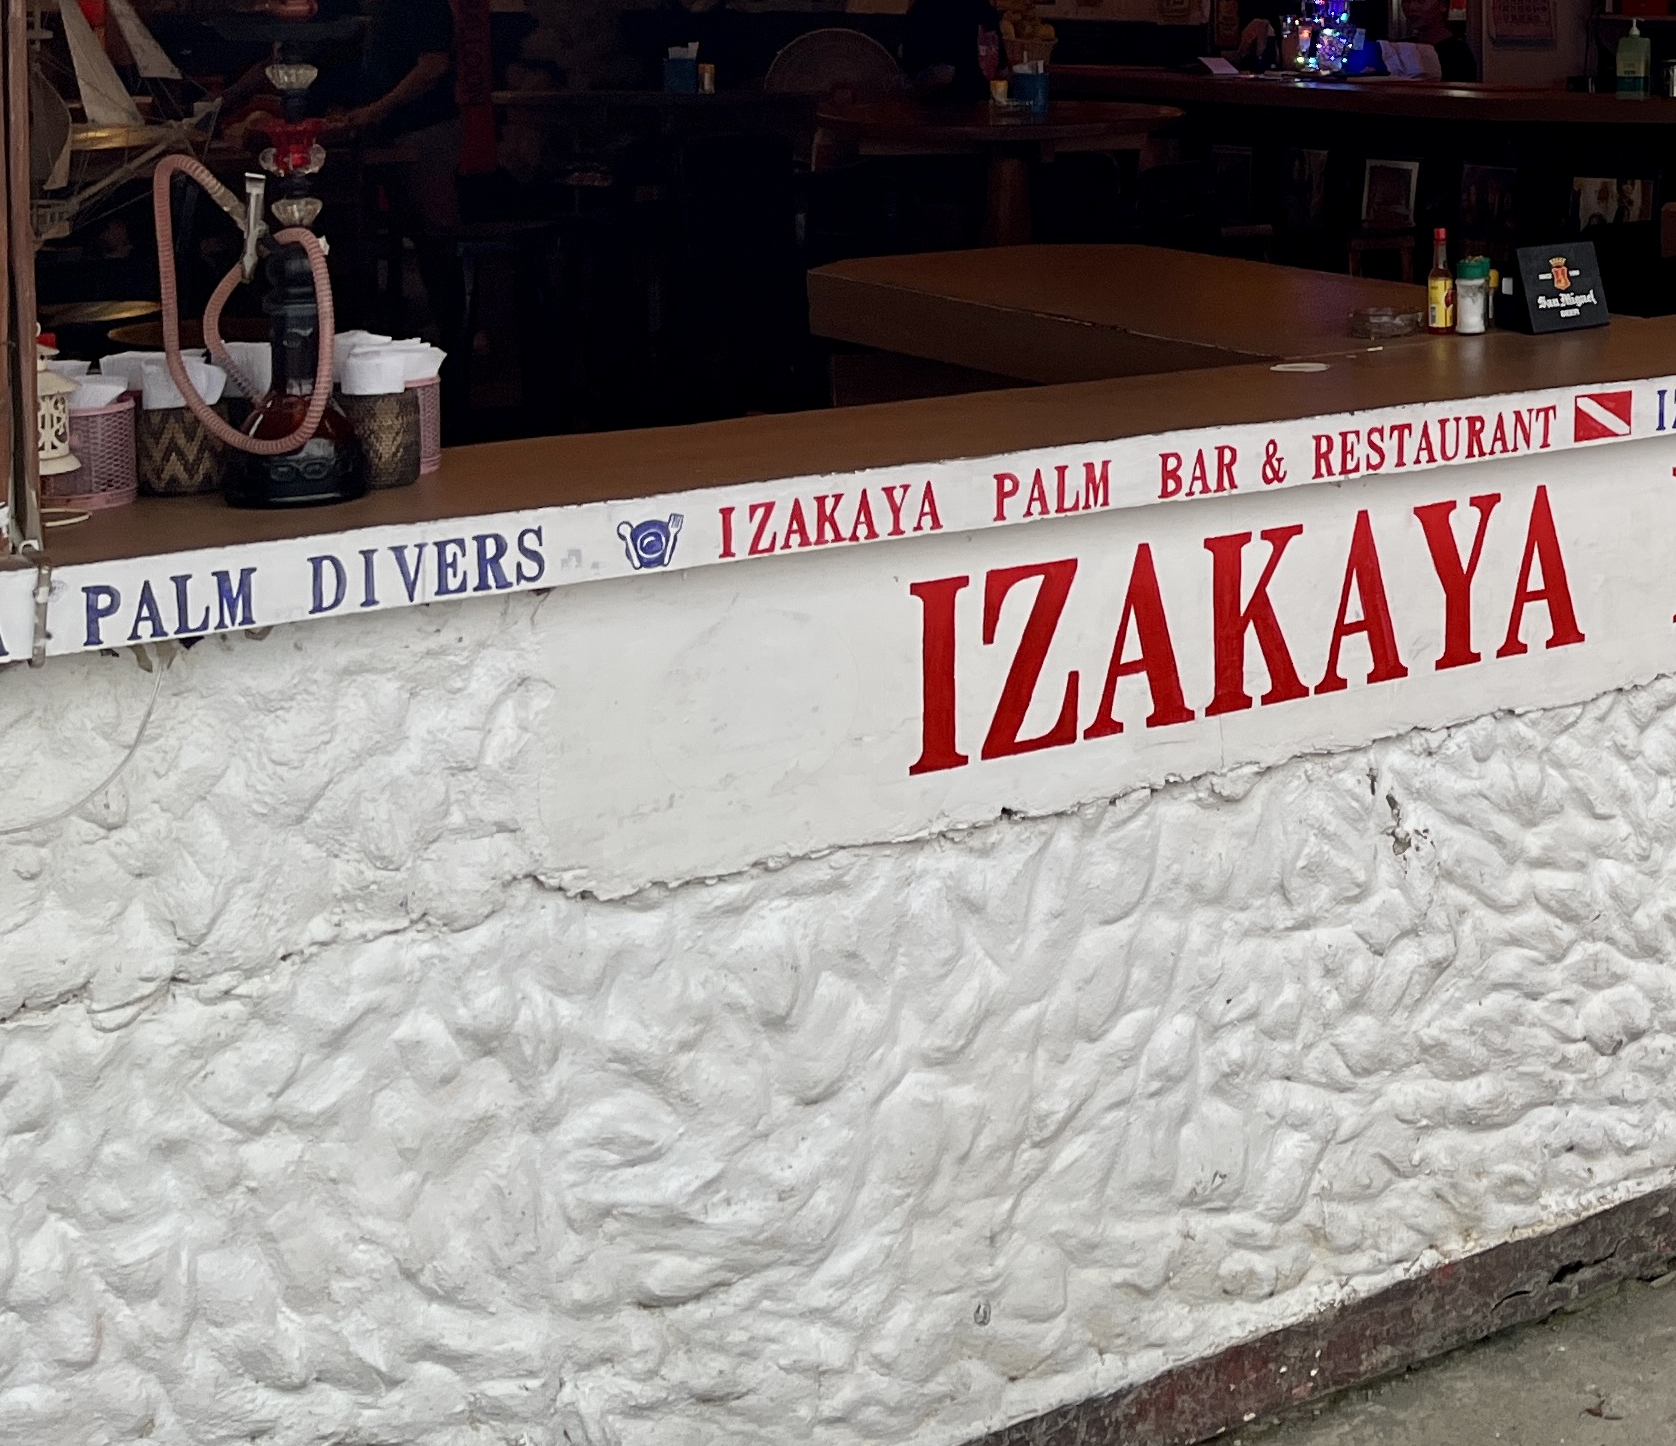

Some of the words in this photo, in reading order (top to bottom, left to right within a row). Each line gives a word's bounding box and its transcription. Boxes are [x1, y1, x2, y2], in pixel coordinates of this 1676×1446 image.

[718, 480, 943, 559] IZAKAYA
[992, 459, 1112, 523] PALM
[1157, 443, 1238, 499] BAR
[1261, 438, 1288, 485] &
[1311, 404, 1557, 480] RESTAURANT
[81, 567, 258, 647] PALM
[306, 525, 548, 615] DIVERS
[909, 484, 1586, 776] IZAKAYA
